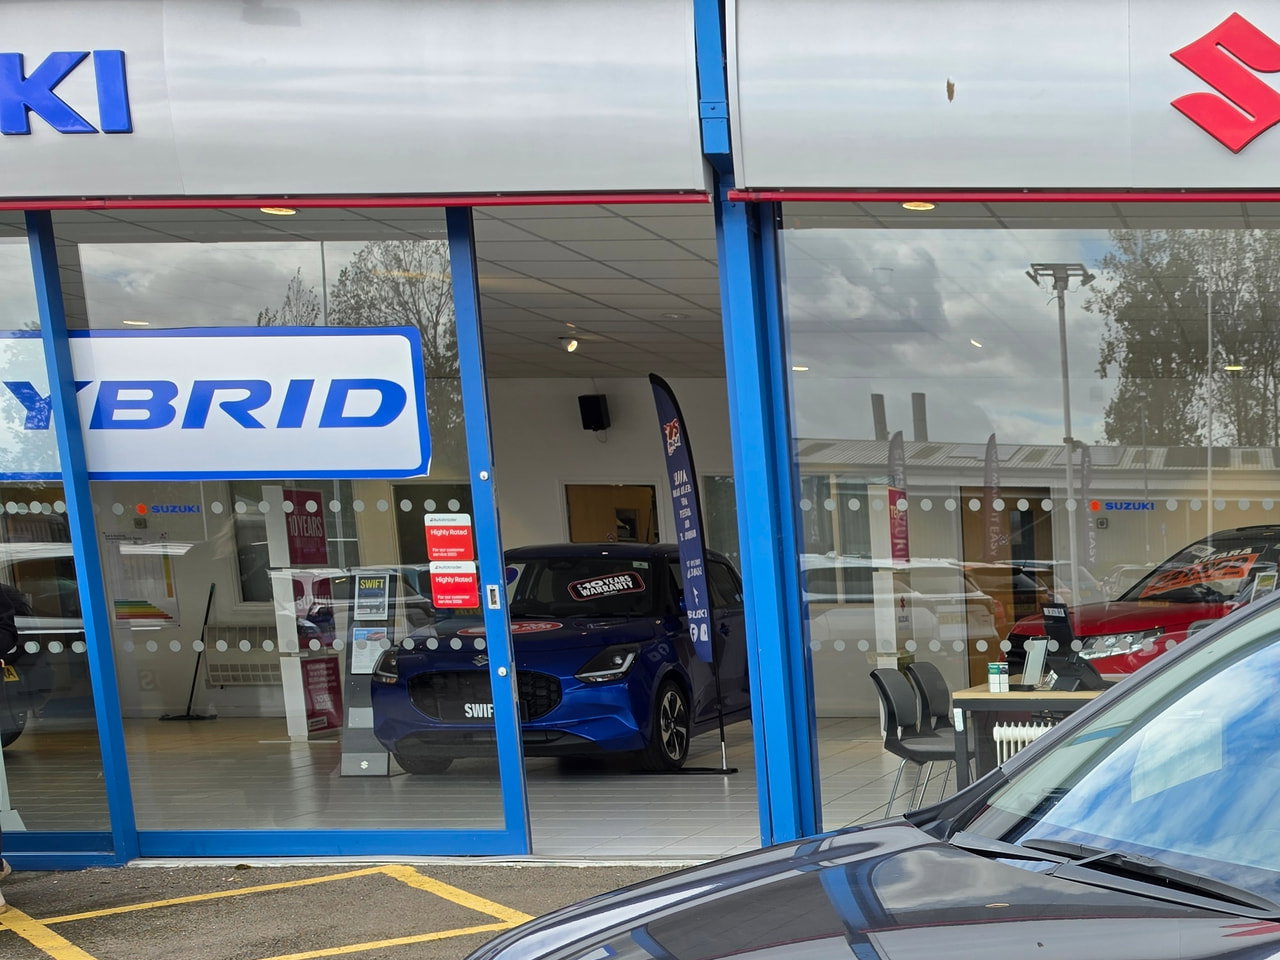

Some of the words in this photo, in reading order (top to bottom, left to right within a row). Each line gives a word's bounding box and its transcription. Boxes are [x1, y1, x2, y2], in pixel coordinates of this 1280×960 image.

[0, 50, 133, 135] KI
[151, 504, 201, 514] SUZUKI
[1104, 501, 1155, 511] SUZUKI
[288, 515, 298, 537] 10
[298, 515, 323, 537] YEARS
[430, 528, 449, 537] Highly
[449, 528, 468, 536] Rated
[360, 579, 385, 589] SWIFT
[435, 576, 454, 584] Highly
[602, 575, 632, 585] YEARS
[581, 581, 633, 597] WARRANTY
[464, 703, 494, 718] SWIF
